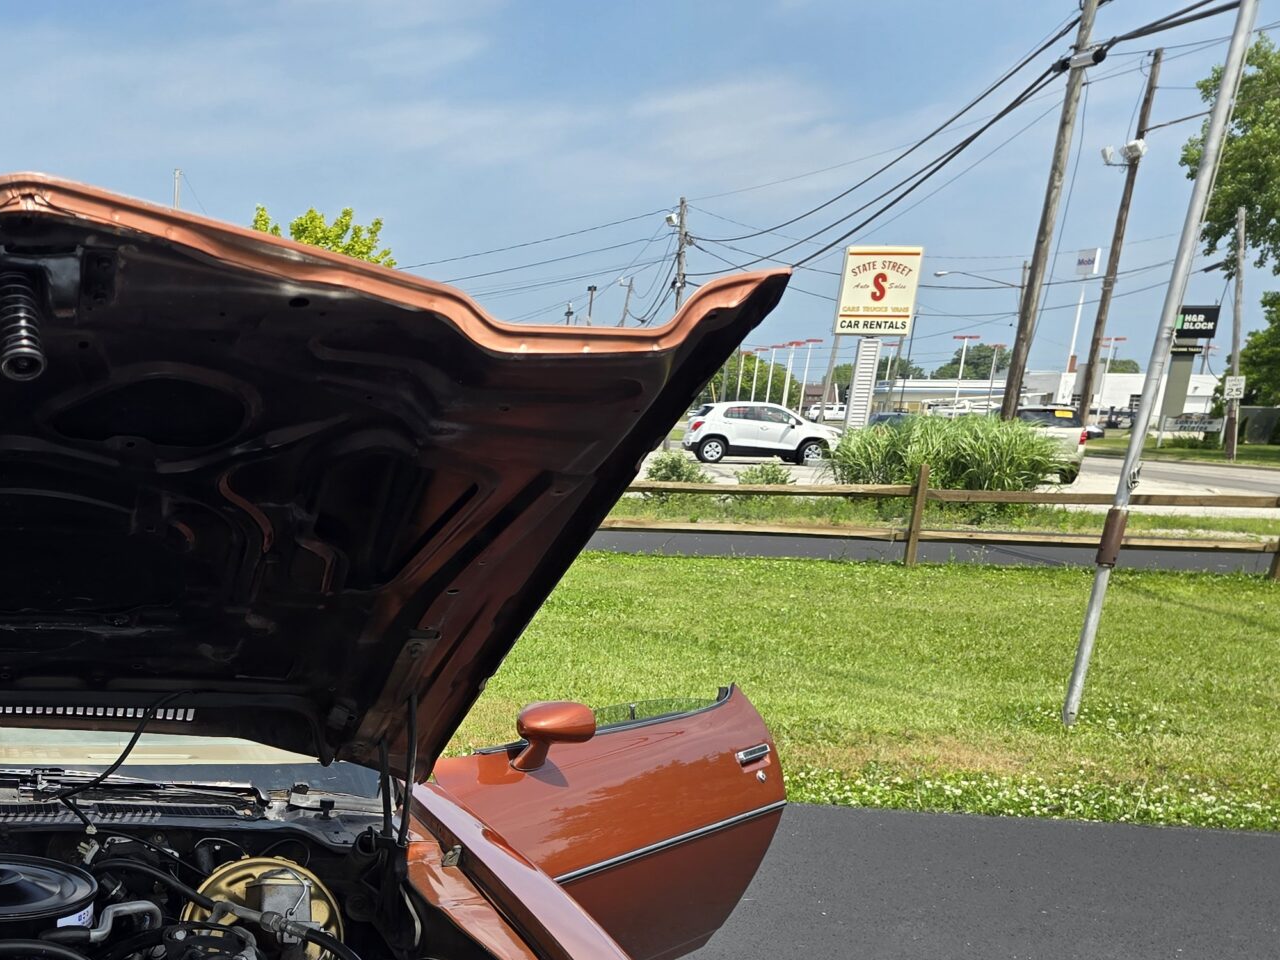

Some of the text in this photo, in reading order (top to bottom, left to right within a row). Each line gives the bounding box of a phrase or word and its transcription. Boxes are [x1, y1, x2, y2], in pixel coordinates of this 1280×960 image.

[851, 260, 913, 277] STATE STREET
[871, 272, 888, 301] S
[1184, 314, 1205, 322] H&R
[840, 320, 907, 330] CAR RENTALS
[1183, 322, 1215, 330] BLOCK
[1226, 388, 1242, 397] 25
